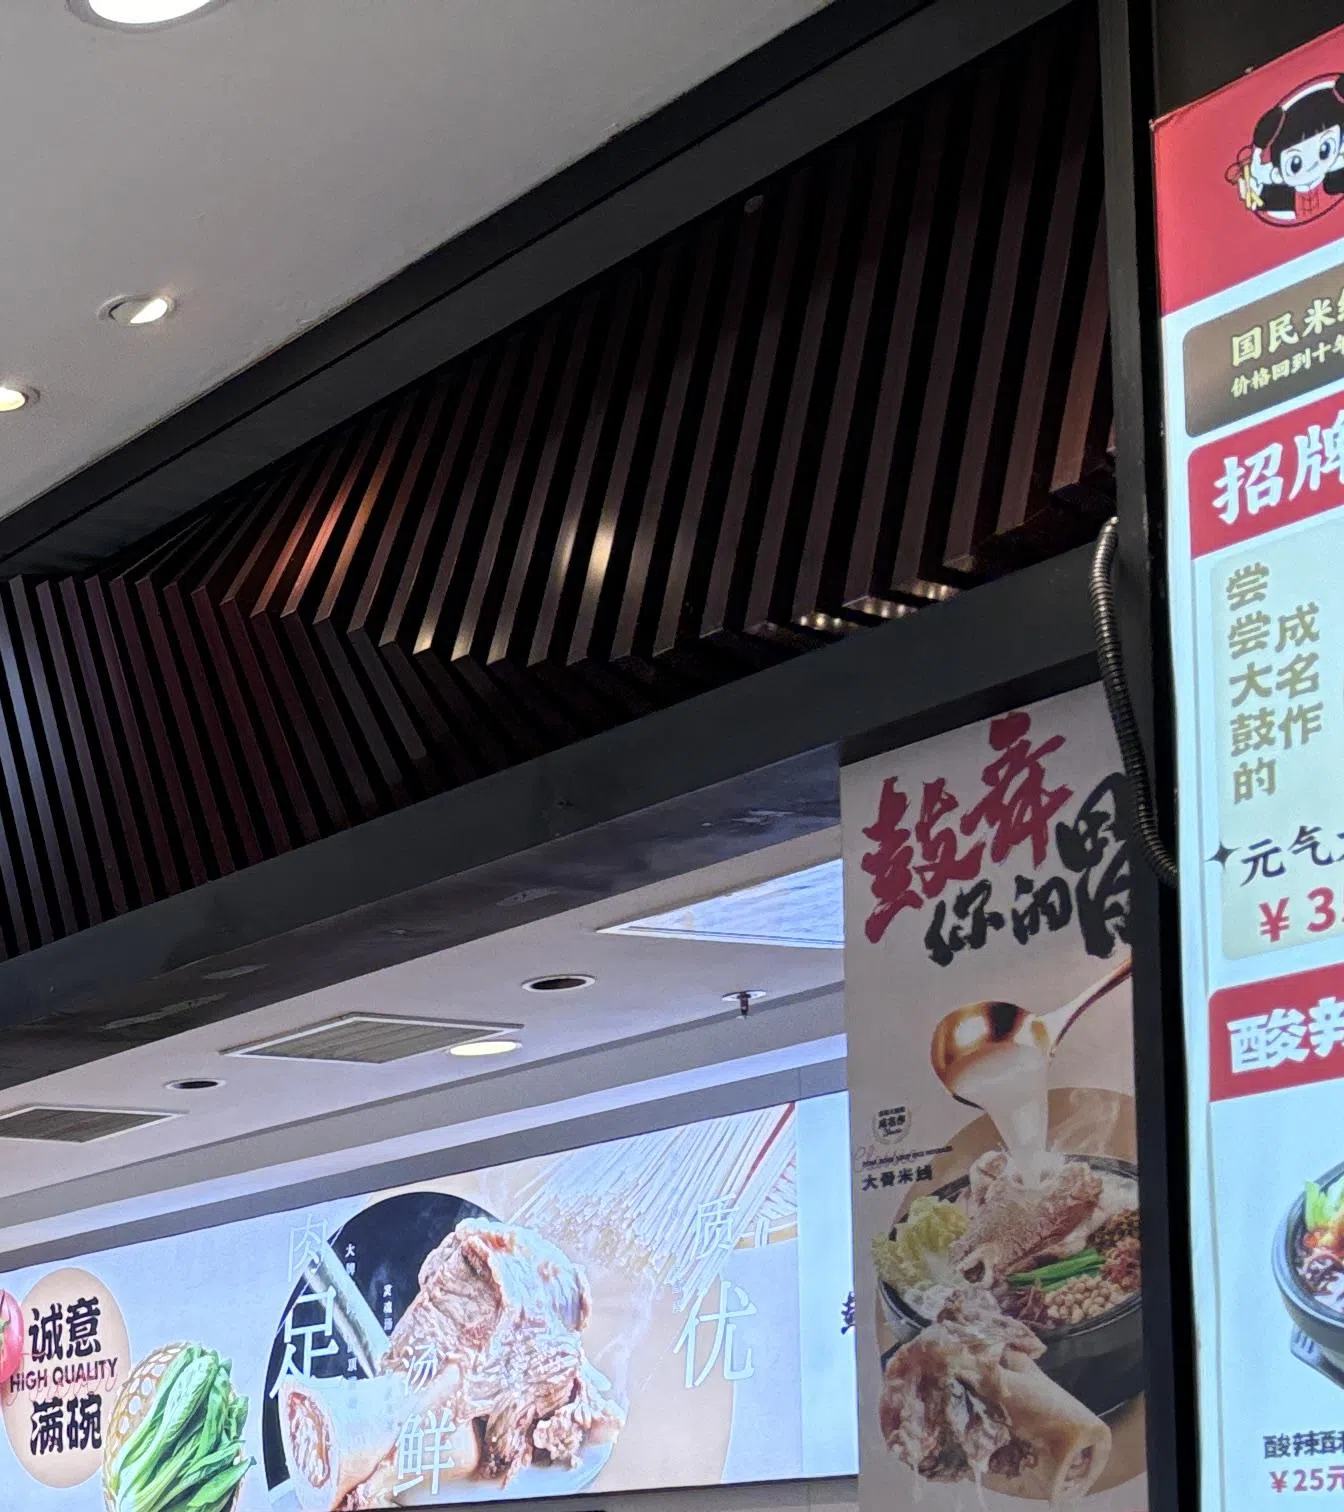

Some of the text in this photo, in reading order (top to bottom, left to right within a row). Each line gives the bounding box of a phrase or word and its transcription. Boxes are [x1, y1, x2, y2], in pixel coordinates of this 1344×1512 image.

[1232, 288, 1344, 367] 国民米
[1226, 562, 1276, 805] 尝尝大鼓的
[1274, 601, 1324, 750] 成名作
[1240, 825, 1344, 887] 元气
[28, 1296, 101, 1363] 诚意
[10, 1357, 118, 1393] HIGH QUALITY
[29, 1394, 102, 1455] 满碗
